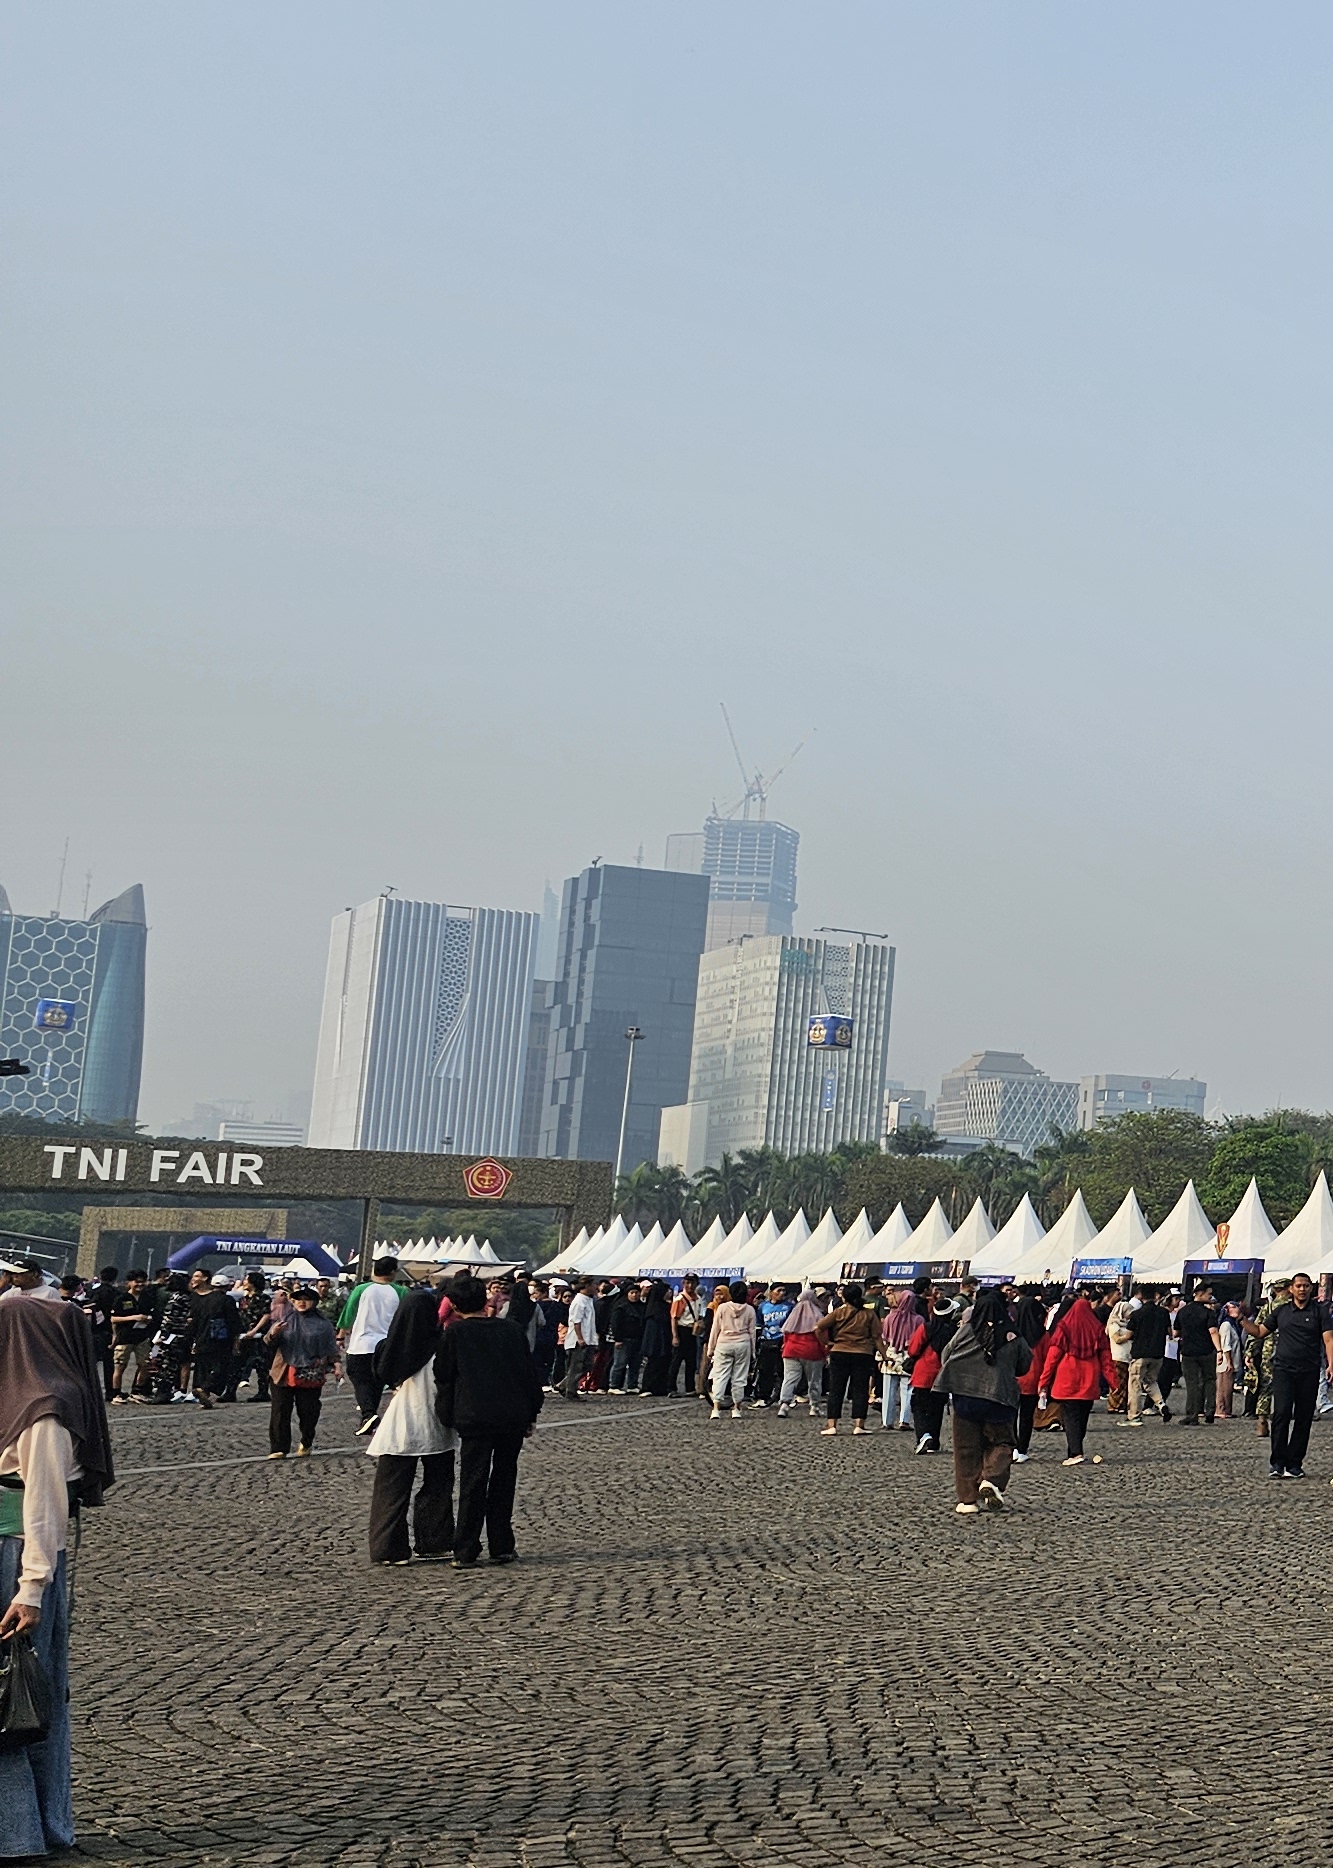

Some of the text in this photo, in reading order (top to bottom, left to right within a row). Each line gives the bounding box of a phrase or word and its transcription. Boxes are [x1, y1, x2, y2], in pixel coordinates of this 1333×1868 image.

[44, 1145, 264, 1186] TNI FAIR
[216, 1241, 300, 1255] TNI ANGKATAN LAUT
